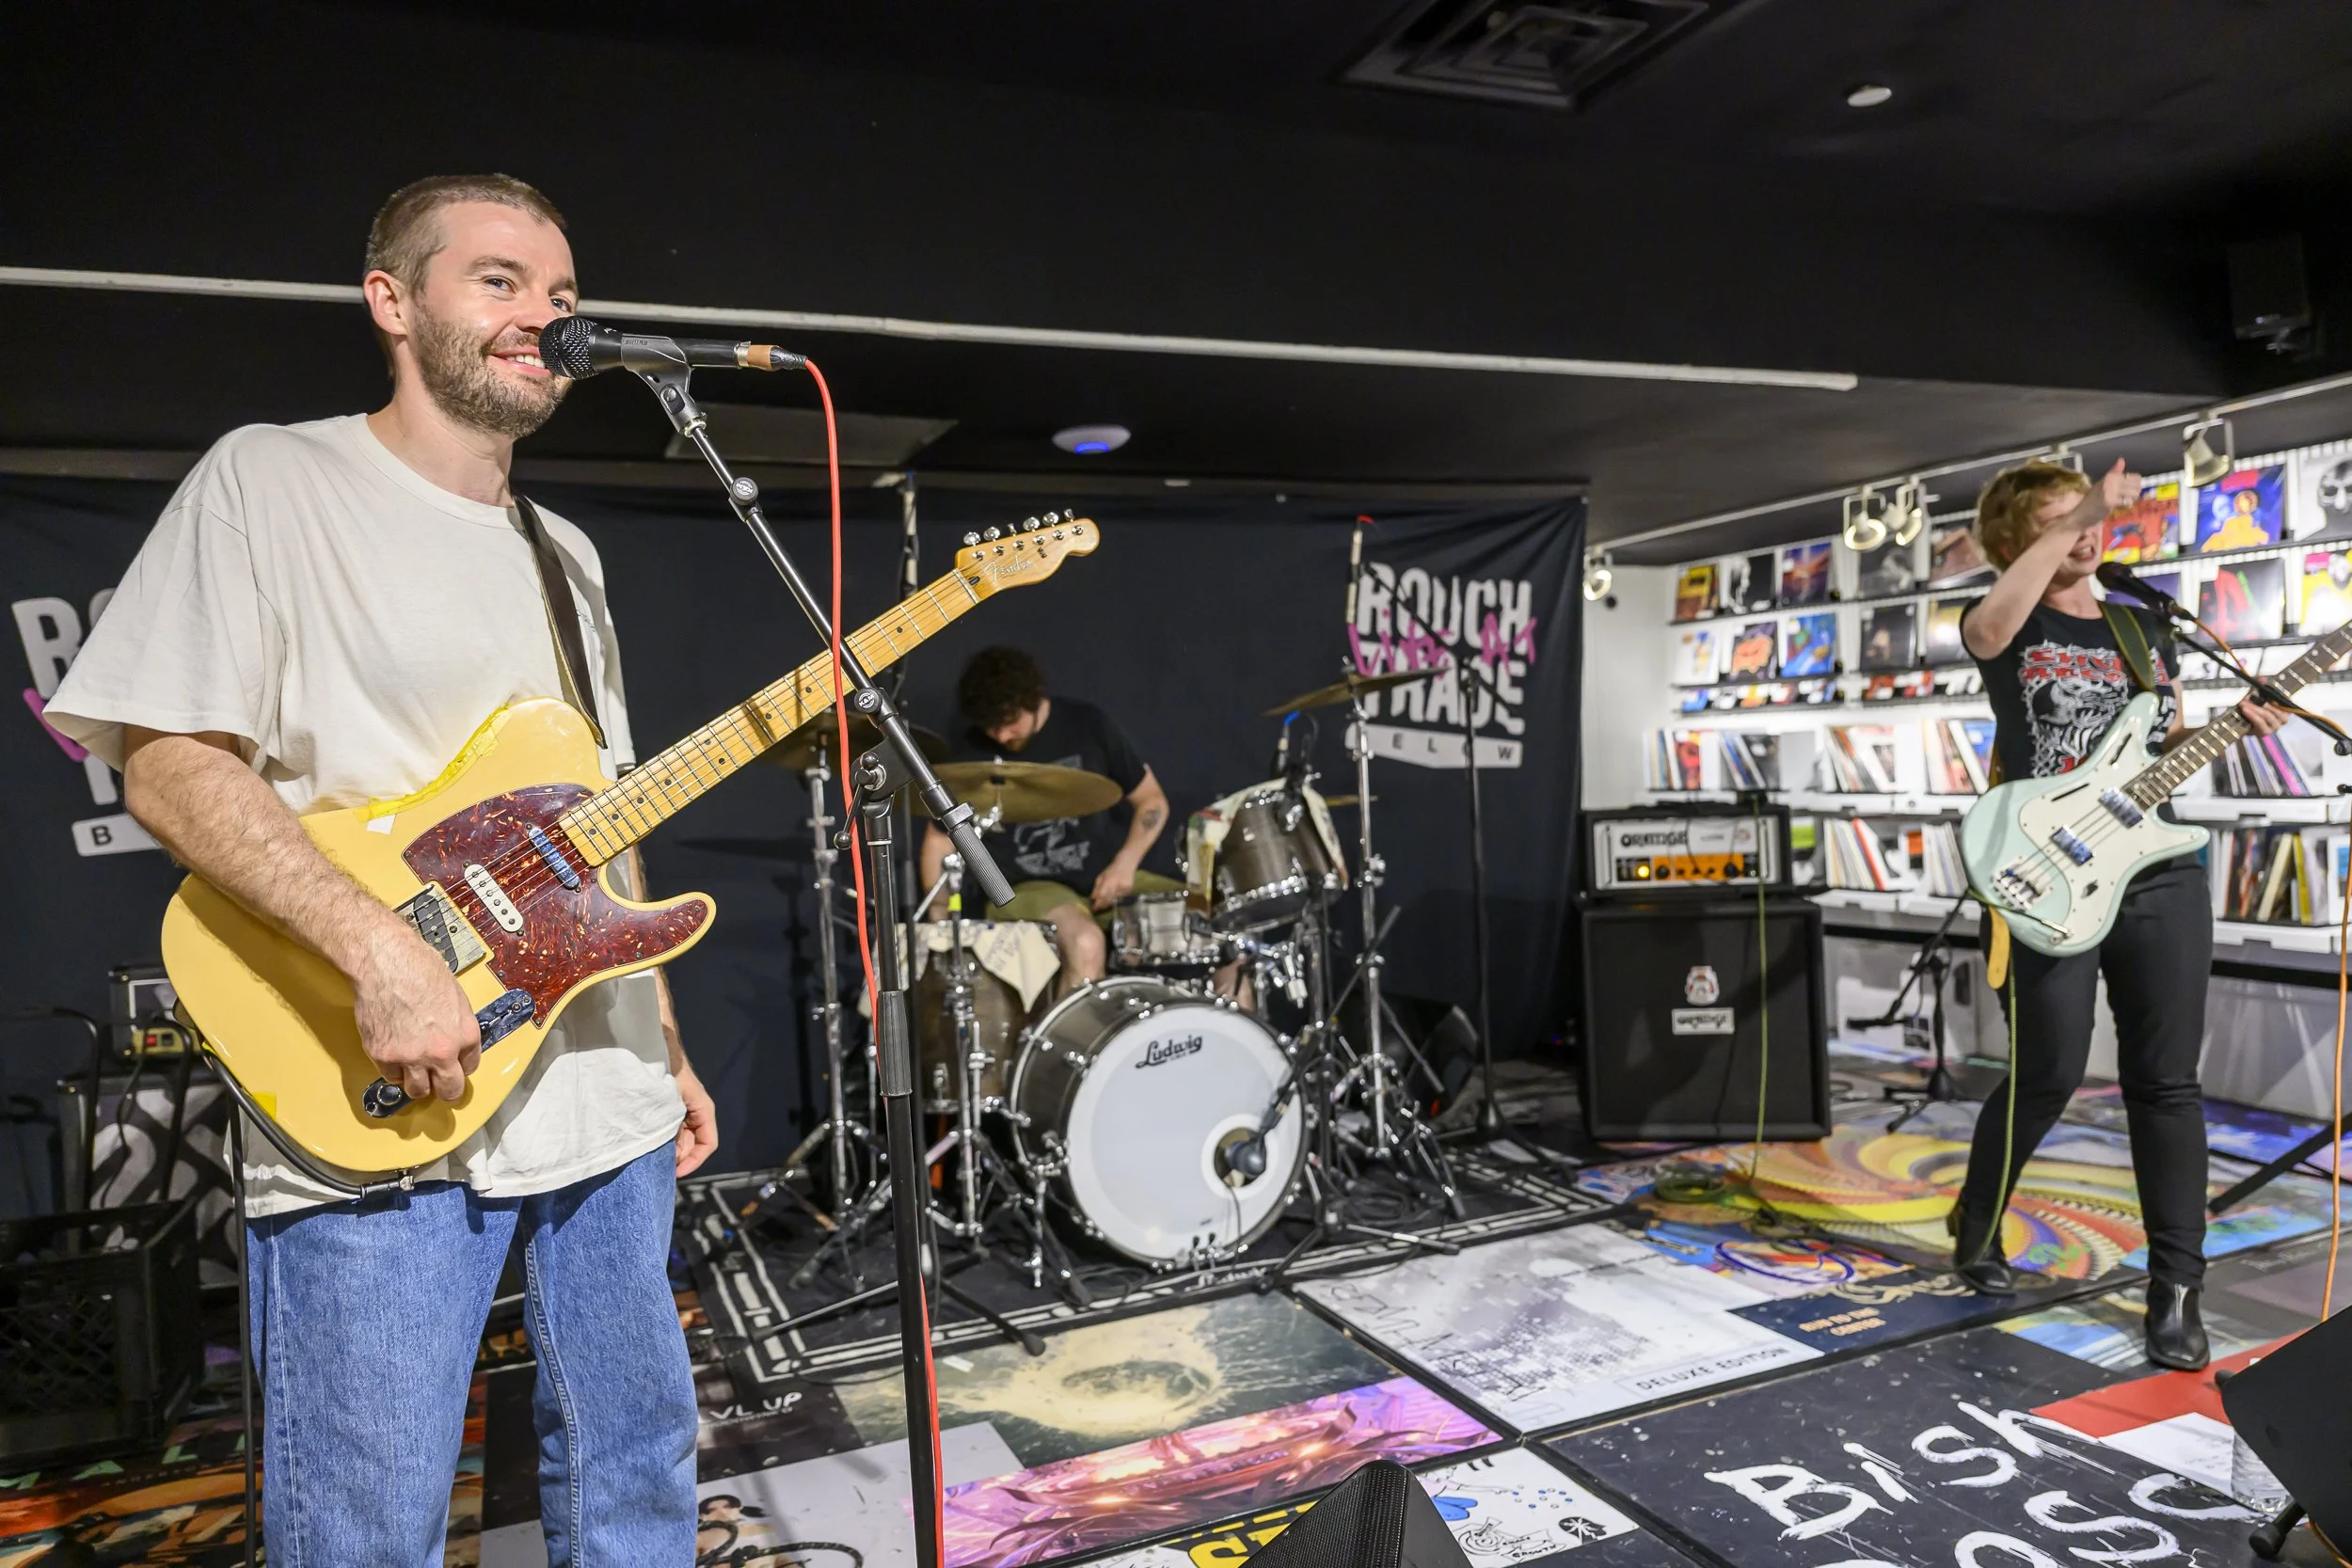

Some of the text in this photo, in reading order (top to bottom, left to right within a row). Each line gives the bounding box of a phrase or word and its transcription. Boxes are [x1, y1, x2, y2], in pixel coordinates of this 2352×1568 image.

[984, 555, 1032, 581] Fender
[1356, 561, 1534, 655] ROUGH
[1359, 641, 1526, 736] TRADE
[1391, 732, 1515, 760] ELW
[1135, 1034, 1203, 1069] Ludwig
[1635, 1365, 1714, 1391] DELUXE
[762, 1391, 803, 1411] UP
